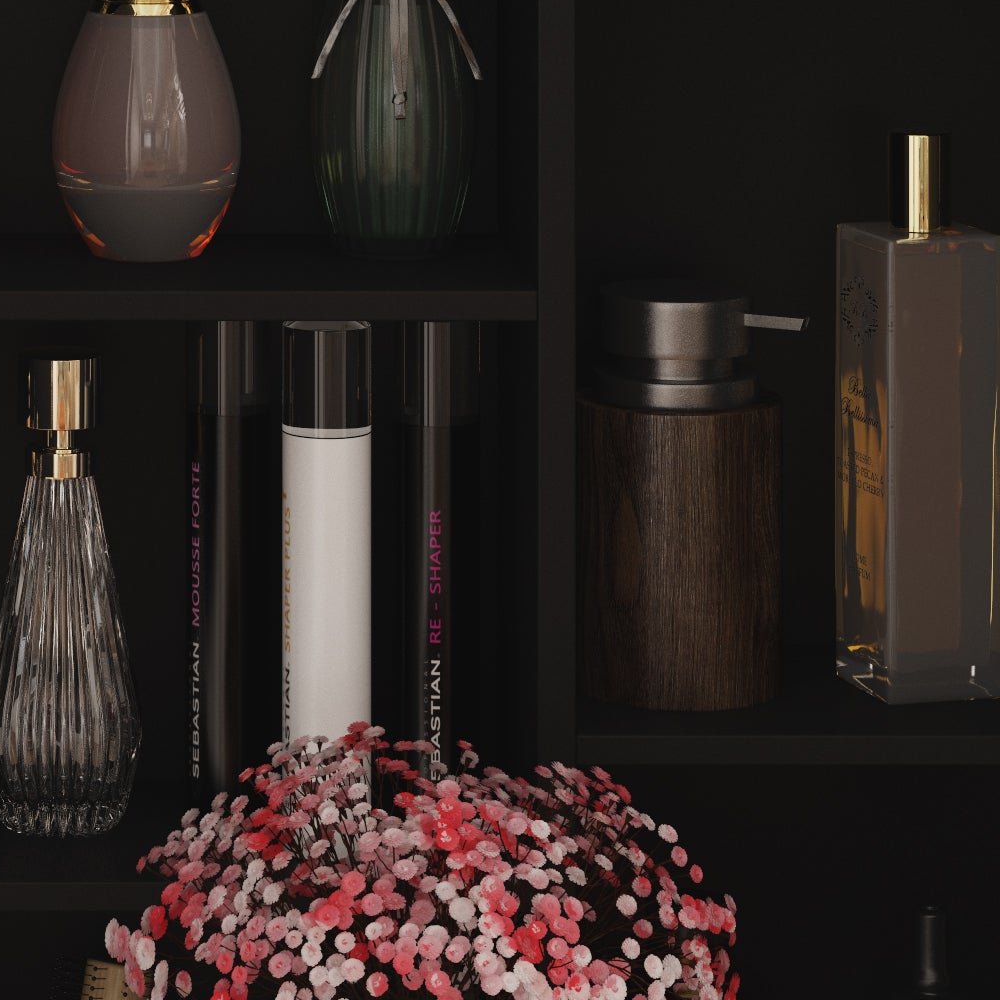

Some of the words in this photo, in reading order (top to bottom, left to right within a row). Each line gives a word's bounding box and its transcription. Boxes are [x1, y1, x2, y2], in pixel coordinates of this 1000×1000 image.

[191, 461, 200, 529] FORTE
[191, 536, 200, 628] MOUSSE
[429, 509, 441, 595] SHAPER
[429, 619, 441, 644] RE
[192, 642, 200, 780] SEBASTIAN
